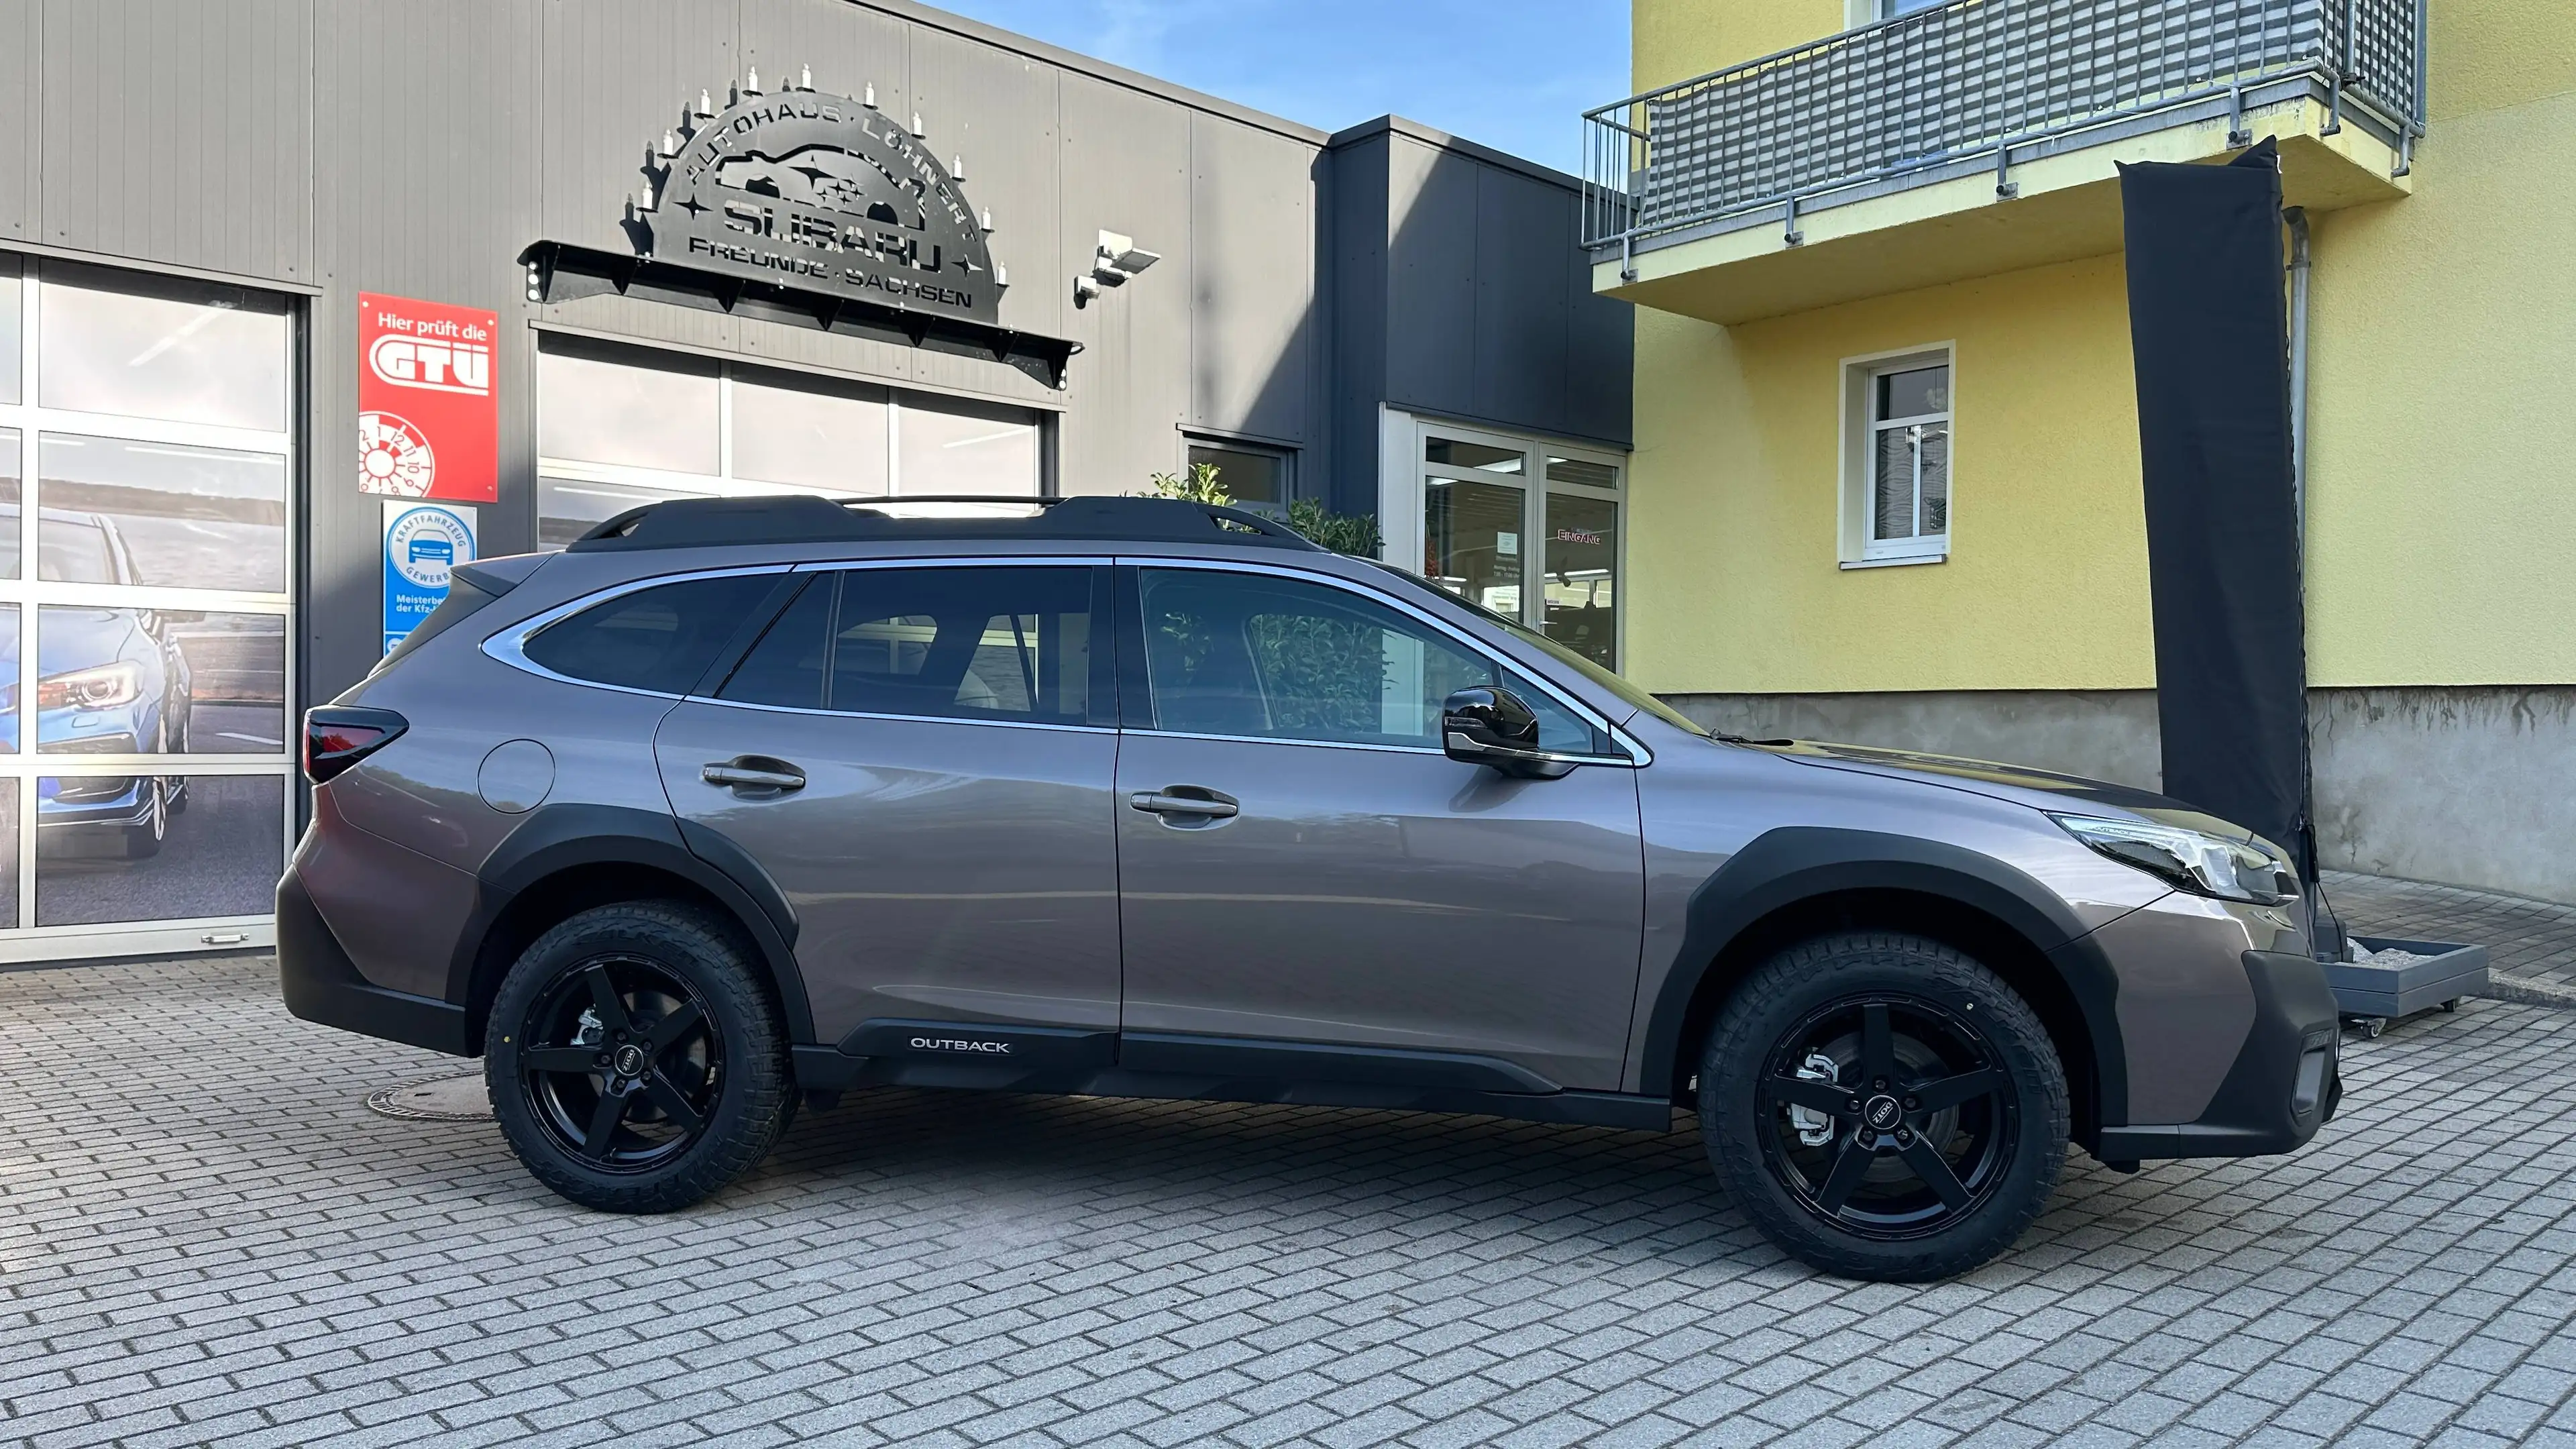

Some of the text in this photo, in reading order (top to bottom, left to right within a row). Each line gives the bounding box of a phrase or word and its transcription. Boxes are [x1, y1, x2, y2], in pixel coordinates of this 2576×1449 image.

[686, 103, 977, 242] AUTOHAUS LÖHNERT
[724, 199, 941, 272] SUBARU
[689, 237, 971, 308] FREUNDE SACHSEN
[378, 312, 487, 341] Hier prüft die
[372, 337, 489, 392] GTÜ
[390, 431, 405, 447] 12
[403, 445, 417, 458] 11
[407, 462, 420, 474] 10
[396, 515, 466, 547] KRAFTFAHRZEUG
[1558, 529, 1601, 545] EINGANG
[406, 566, 450, 583] GEWERB
[396, 603, 412, 612] der
[910, 1037, 1010, 1054] OUTBACK
[622, 1049, 635, 1071] DOTZ
[1872, 1102, 1893, 1124] DOTZ
